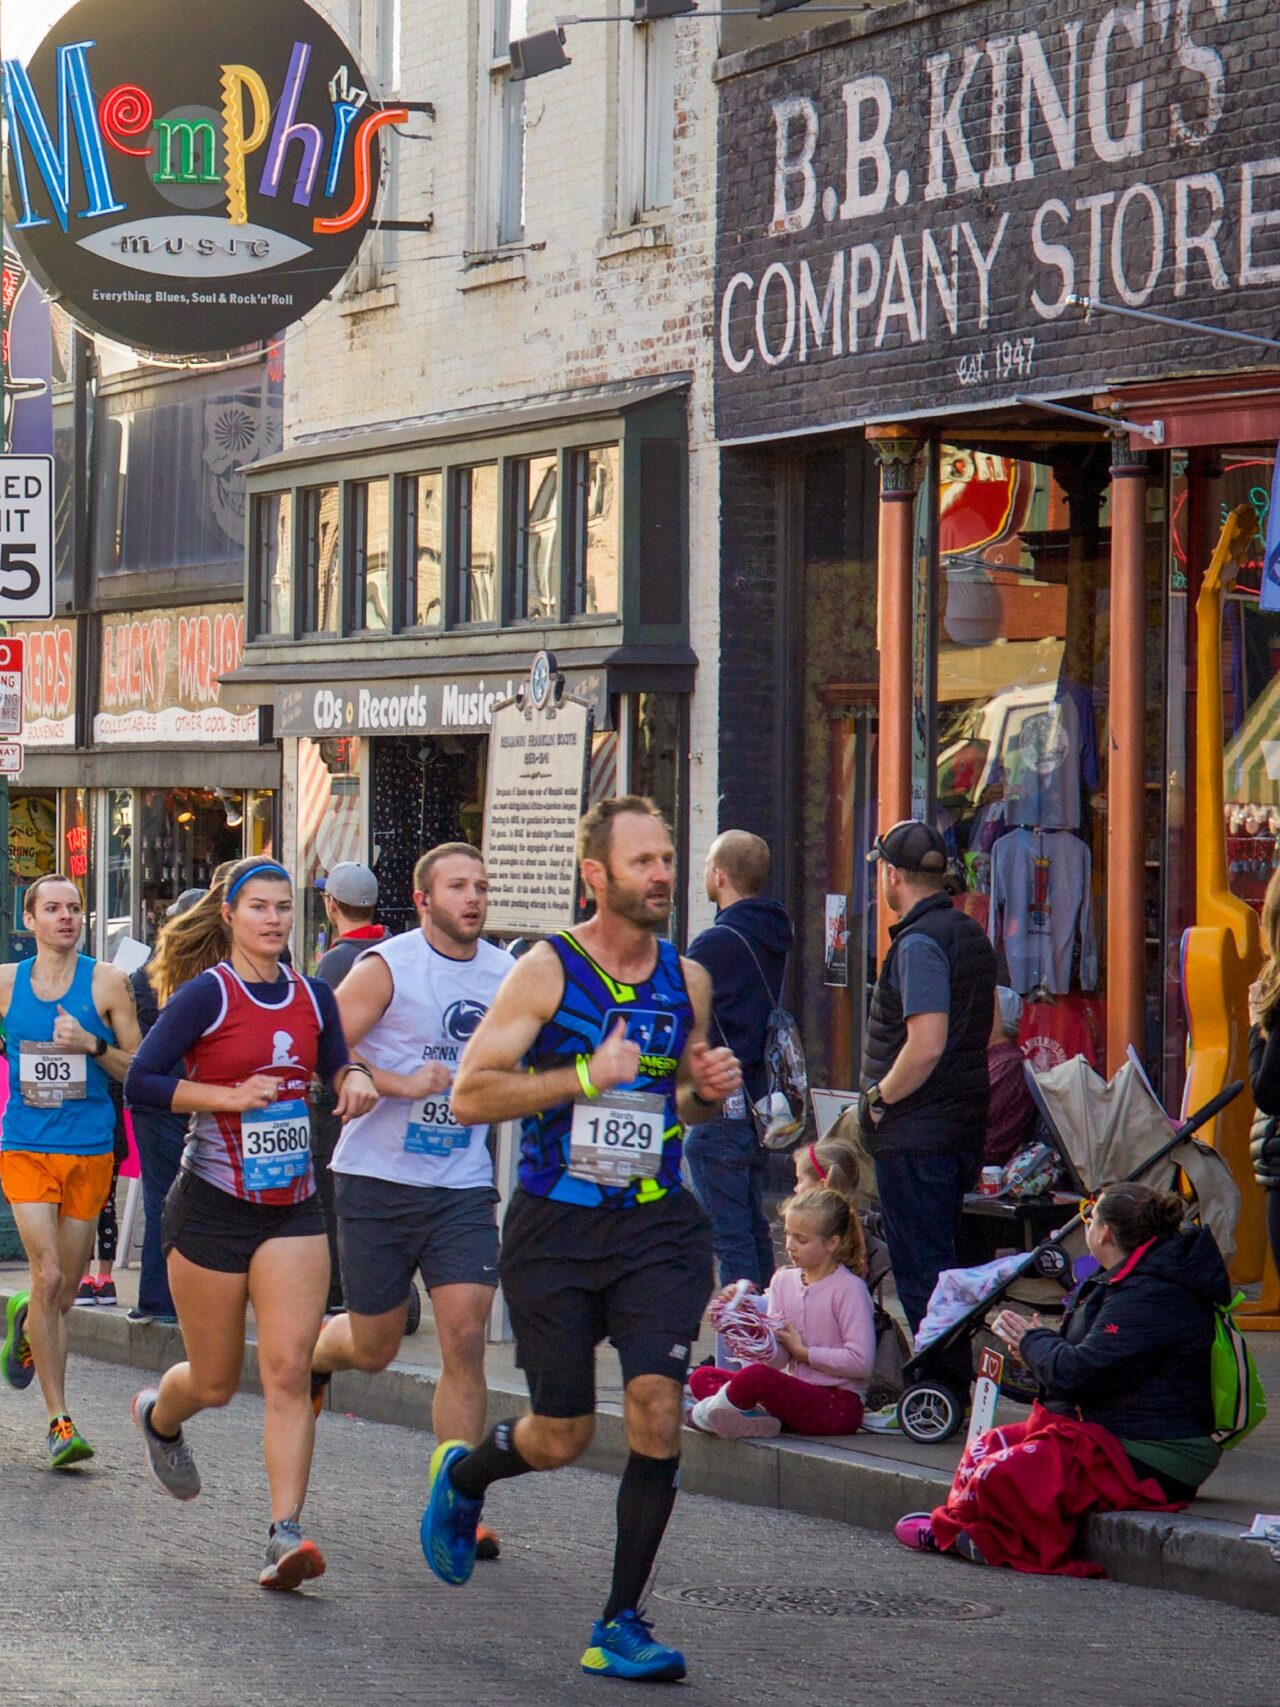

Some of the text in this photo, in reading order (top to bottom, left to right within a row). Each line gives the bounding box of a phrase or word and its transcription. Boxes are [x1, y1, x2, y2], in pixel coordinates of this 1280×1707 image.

[2, 40, 408, 234] Memphis
[721, 156, 1280, 373] COMPANY STORE
[92, 289, 293, 306] Everything Blues, Soul & Rock'n'Roll
[995, 337, 1035, 379] 1947
[104, 612, 245, 709] LUCKY MOJO
[313, 689, 343, 730] CDs
[358, 684, 428, 728] Records
[100, 715, 157, 734] COLLECTABLES
[175, 714, 202, 733] OTHER
[205, 714, 227, 733] COOL
[230, 714, 257, 733] STUFF
[8, 846, 36, 857] SHING
[422, 1045, 460, 1061] PENN
[34, 1061, 71, 1081] 903
[247, 1125, 308, 1156] 35680
[587, 1117, 653, 1150] 1829
